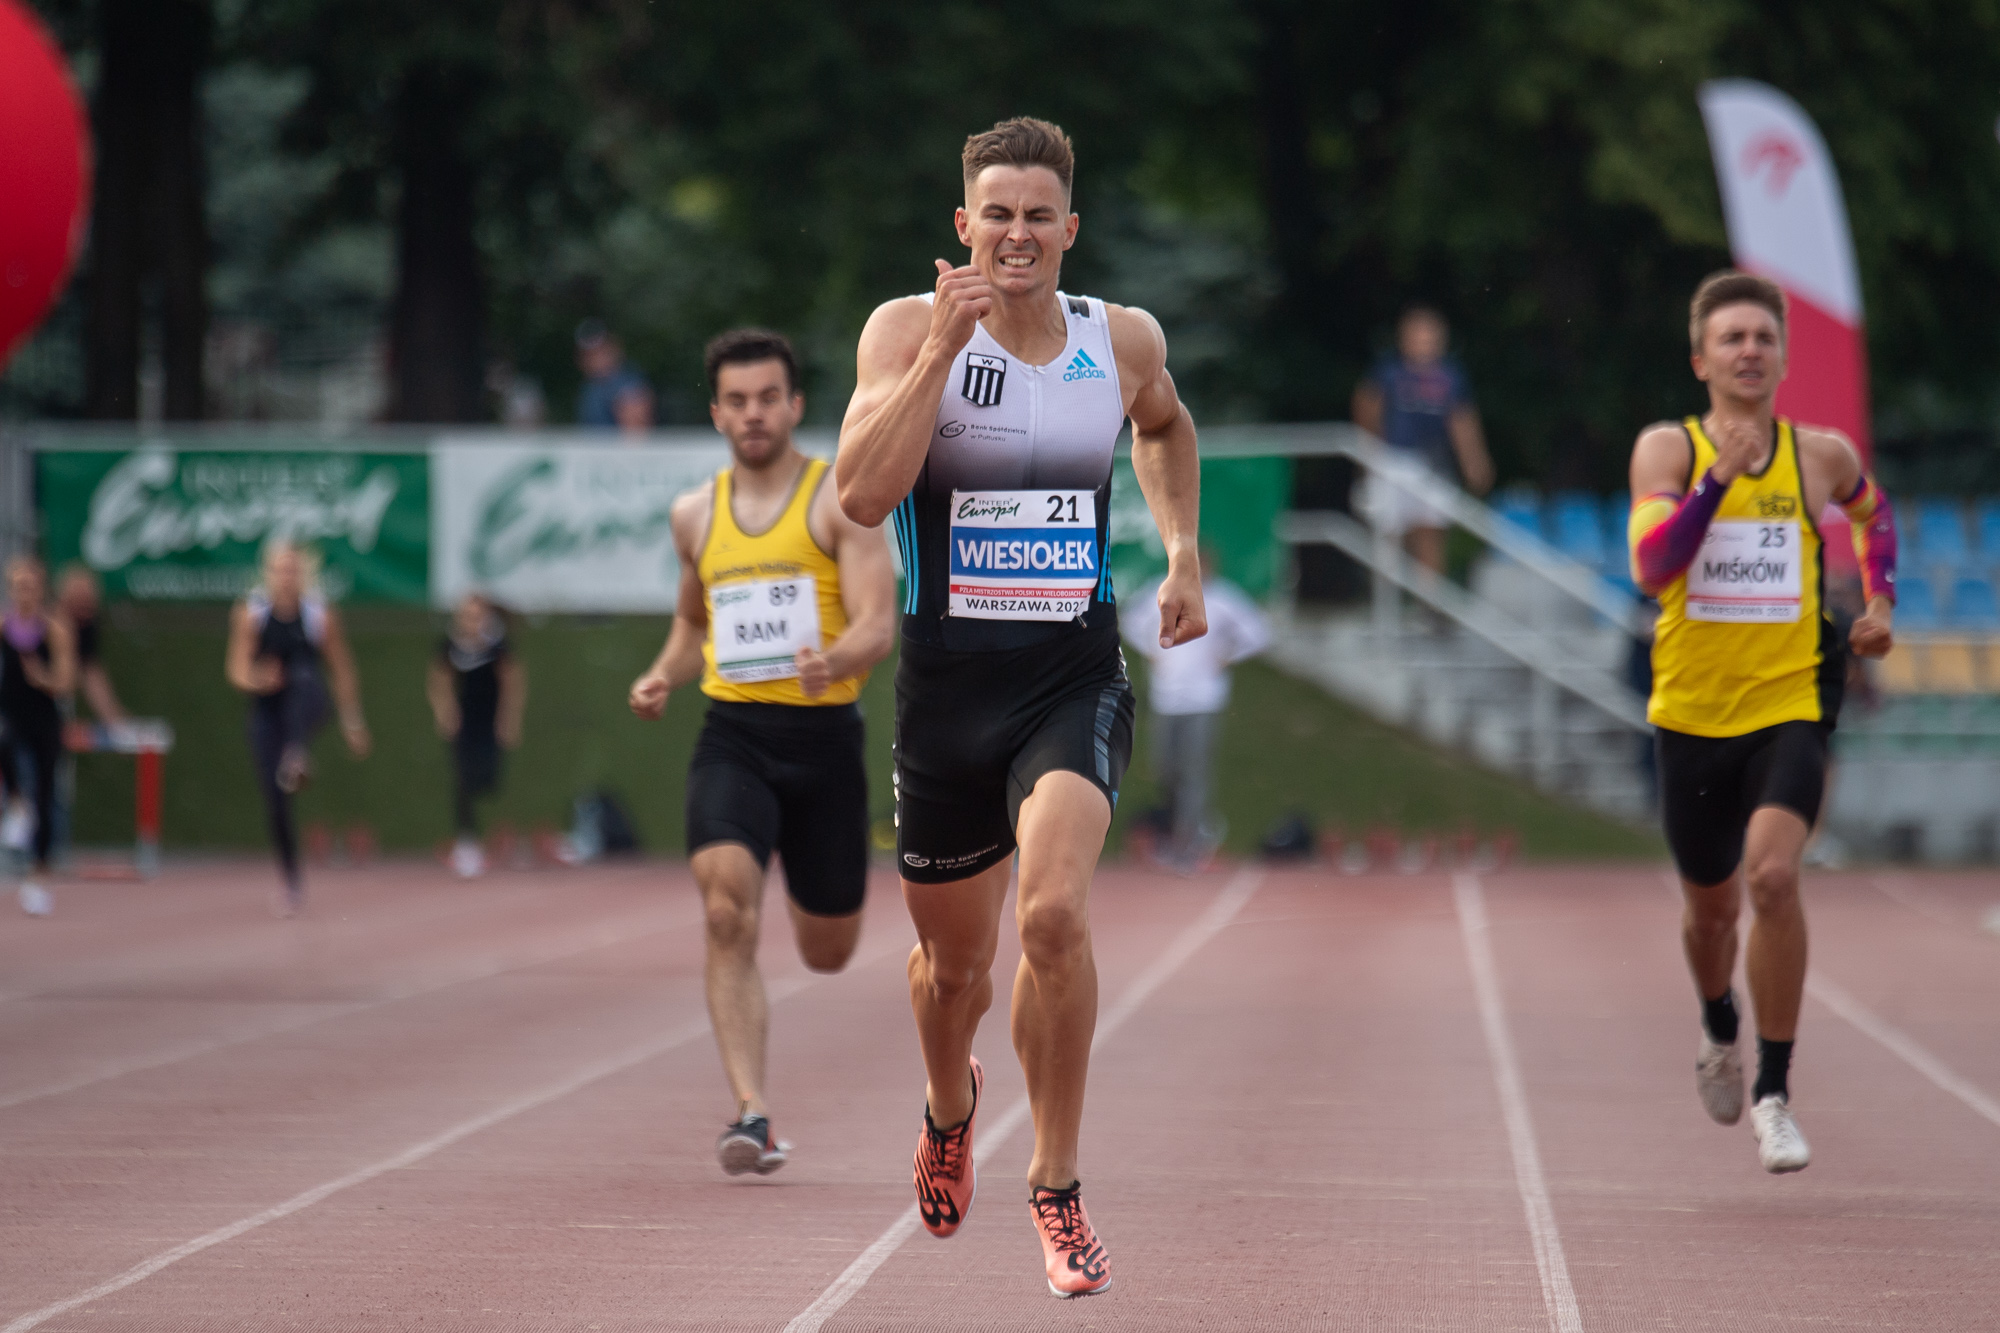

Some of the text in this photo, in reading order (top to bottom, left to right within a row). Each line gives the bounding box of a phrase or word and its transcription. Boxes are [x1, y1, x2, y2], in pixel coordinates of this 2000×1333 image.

[982, 358, 994, 366] W
[1063, 366, 1106, 382] adidas
[957, 497, 1021, 522] Europol
[1046, 495, 1080, 523] 21
[1759, 527, 1786, 548] 25
[957, 540, 1095, 570] WIESIOŁEK
[1703, 556, 1789, 583] MIŚKÓW
[769, 585, 798, 607] 89
[974, 587, 1014, 596] MISTRZOSTWA
[966, 598, 1084, 613] WARSZAWA 202
[734, 620, 790, 645] RAM
